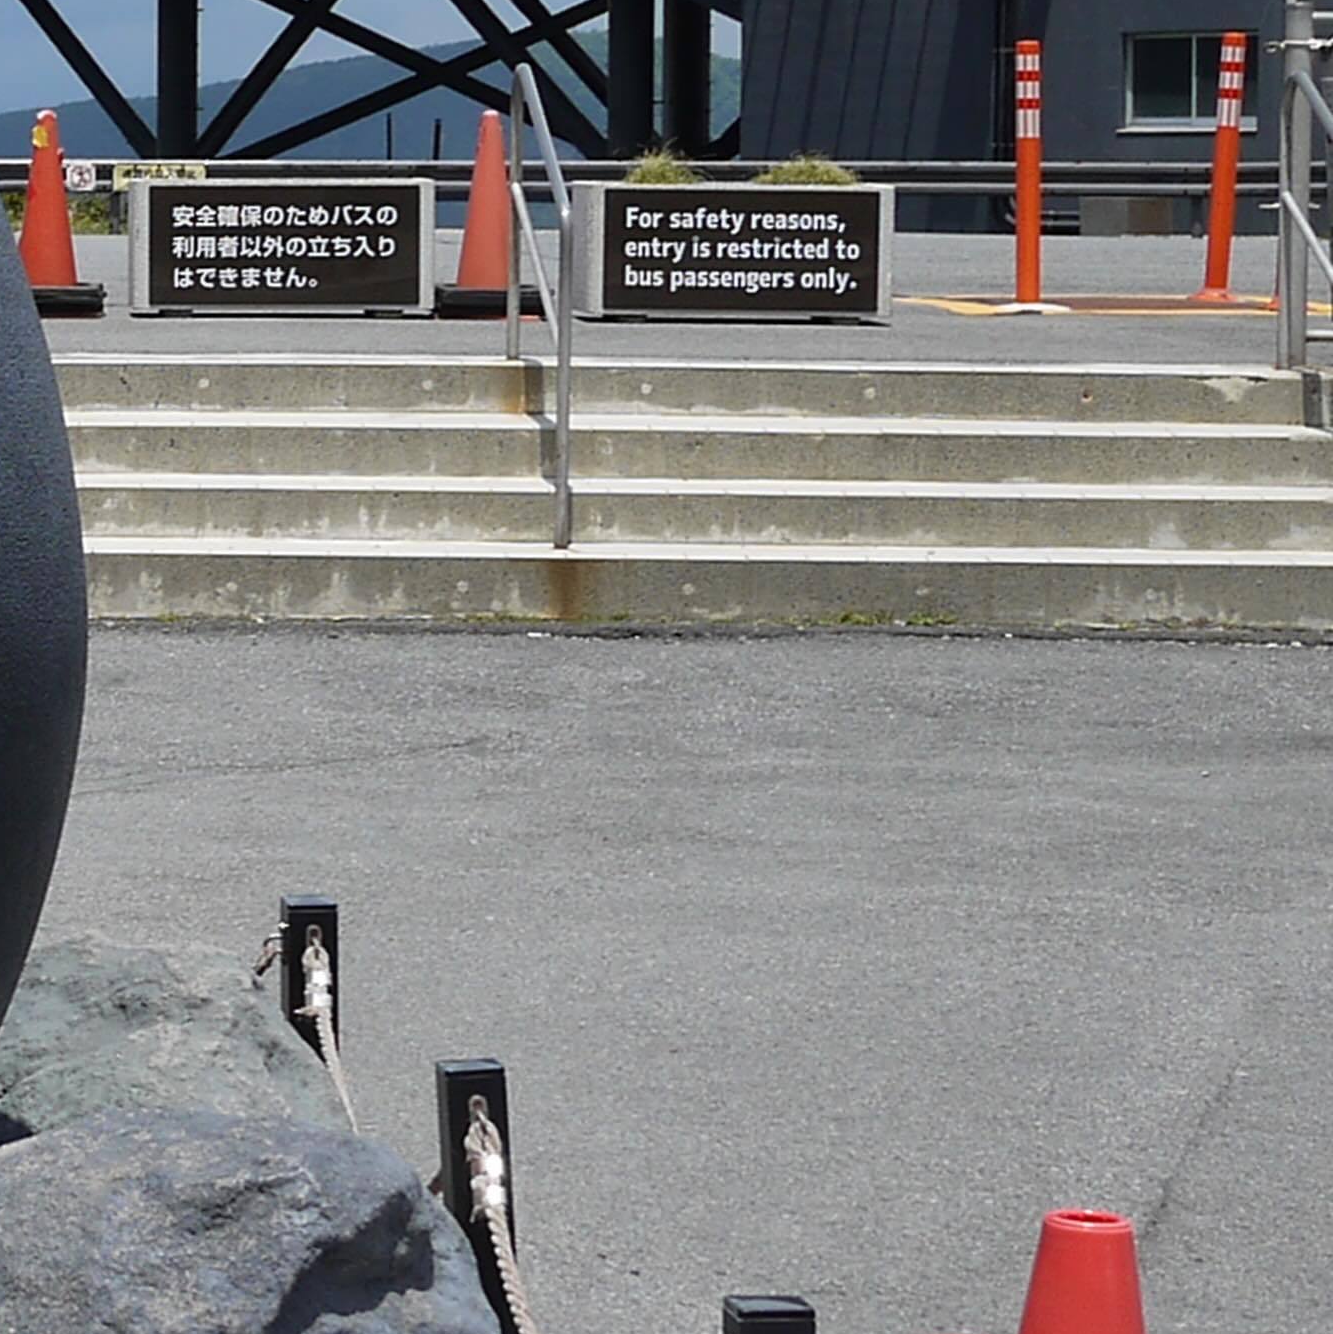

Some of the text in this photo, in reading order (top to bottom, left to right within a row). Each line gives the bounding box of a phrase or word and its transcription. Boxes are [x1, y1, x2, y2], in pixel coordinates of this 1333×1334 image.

[172, 205, 398, 228] 安全確保のためバスの
[625, 207, 846, 234] For safety reasons,
[172, 236, 396, 259] 利用者以外の立ち入り
[624, 236, 860, 263] entry is restricted to
[173, 267, 319, 288] はできません。
[624, 265, 857, 294] bus passengers only.
